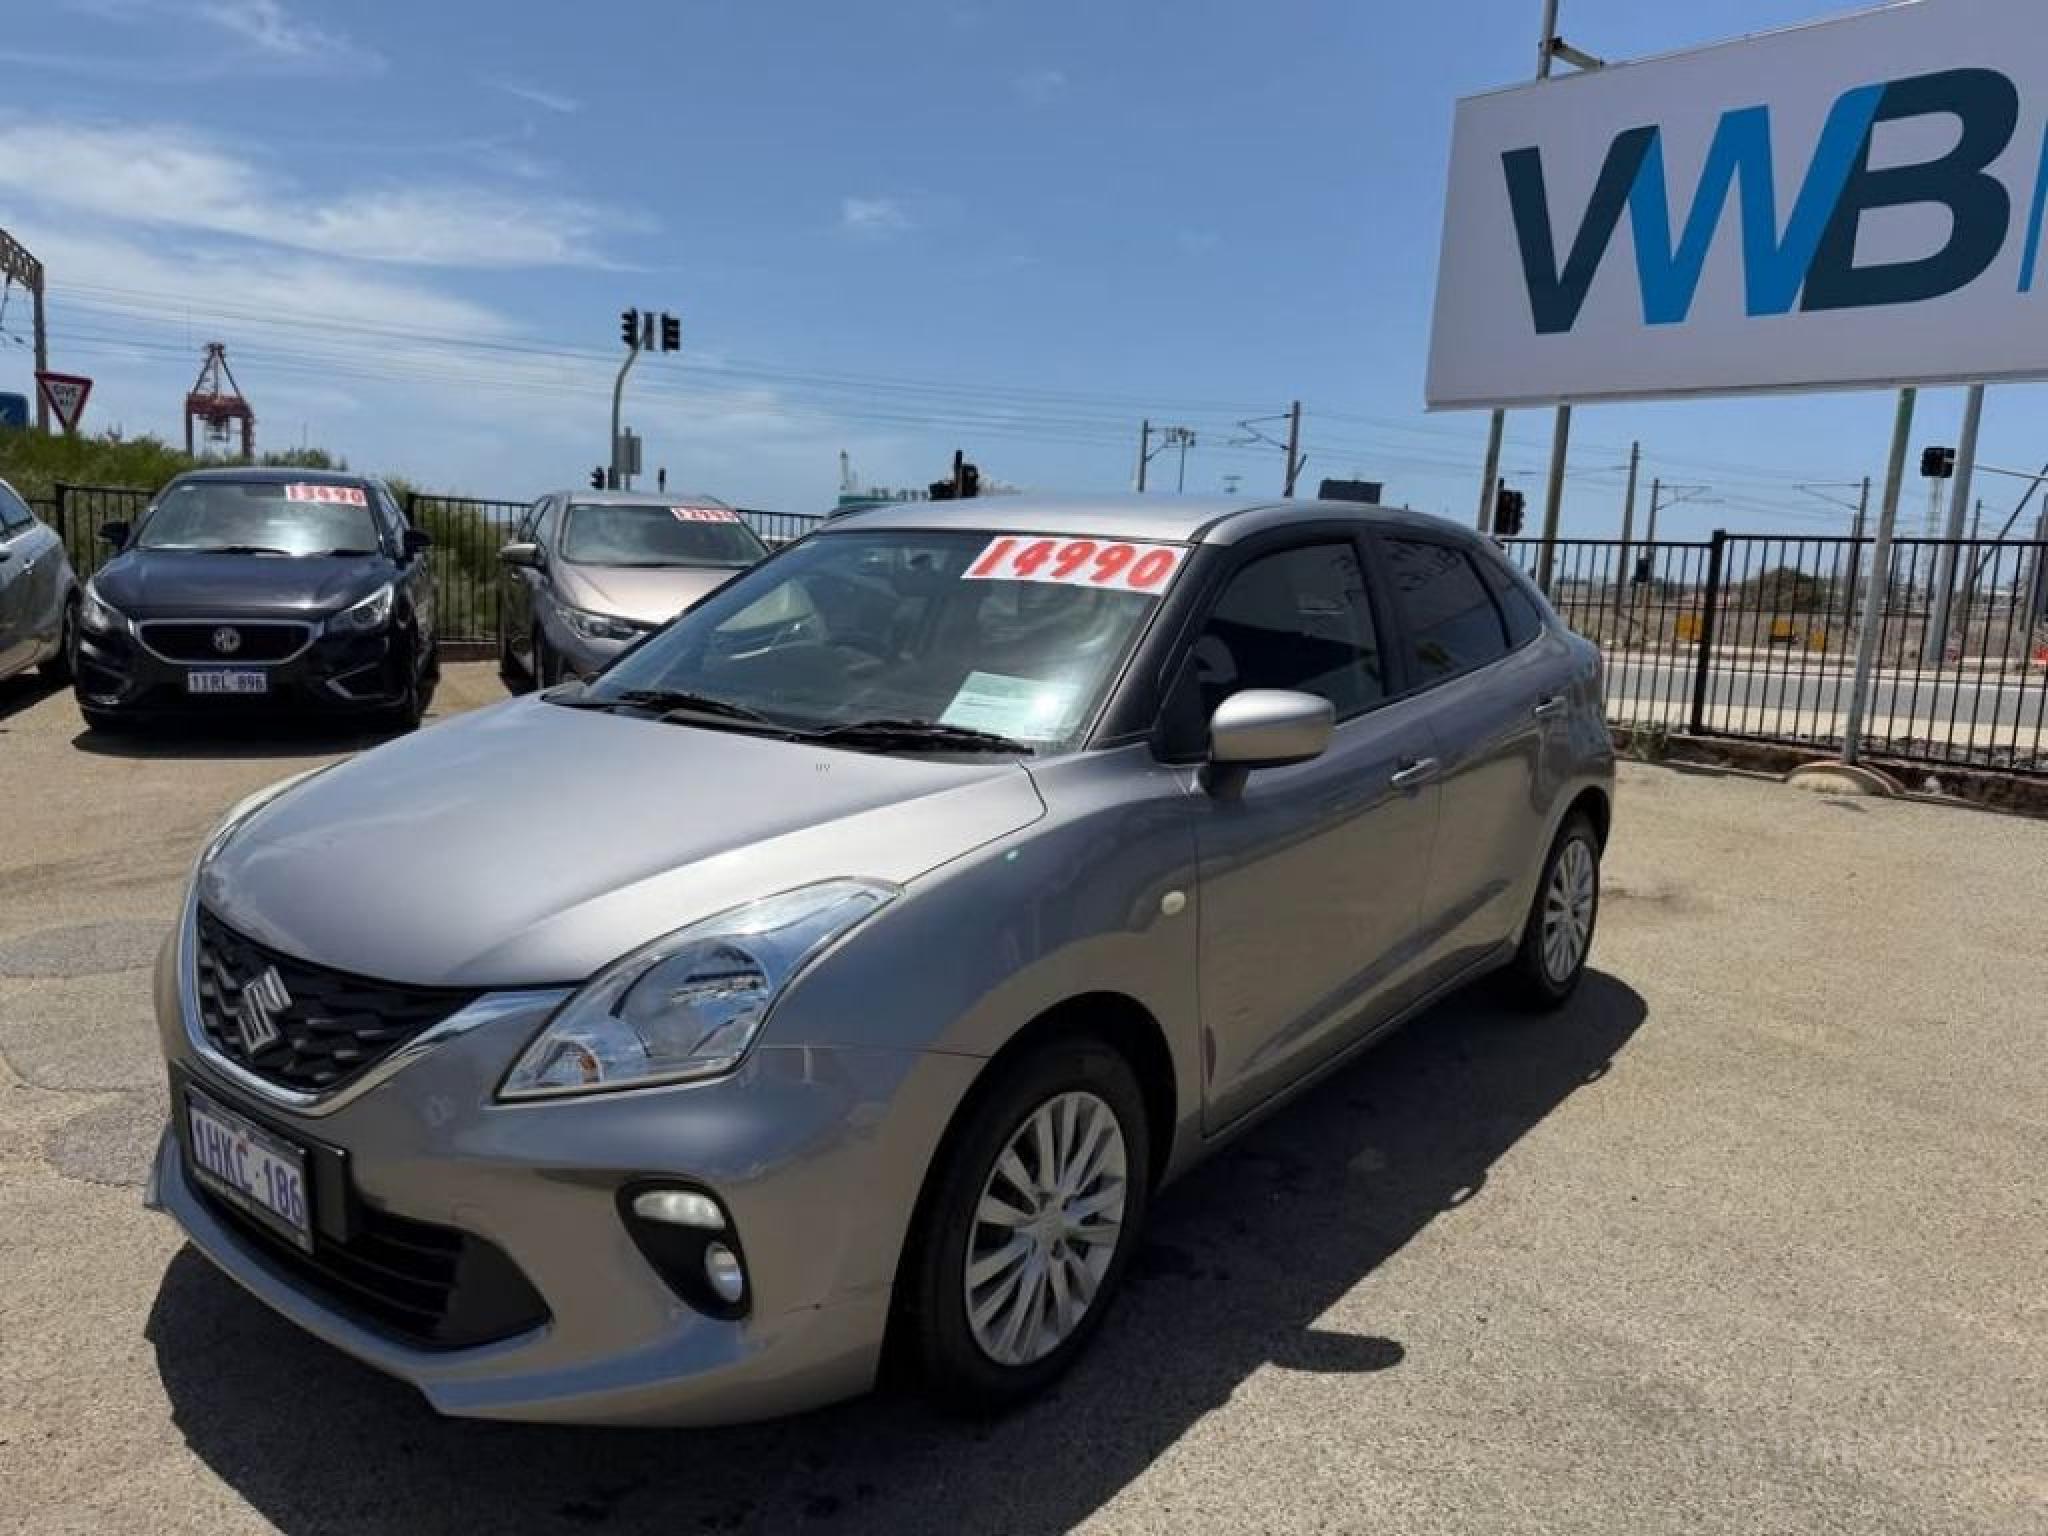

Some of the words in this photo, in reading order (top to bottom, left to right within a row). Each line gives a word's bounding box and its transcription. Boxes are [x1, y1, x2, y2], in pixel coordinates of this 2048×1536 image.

[972, 539, 1175, 588] 14990
[195, 1118, 253, 1193] 1HKC
[263, 1158, 306, 1230] 186
